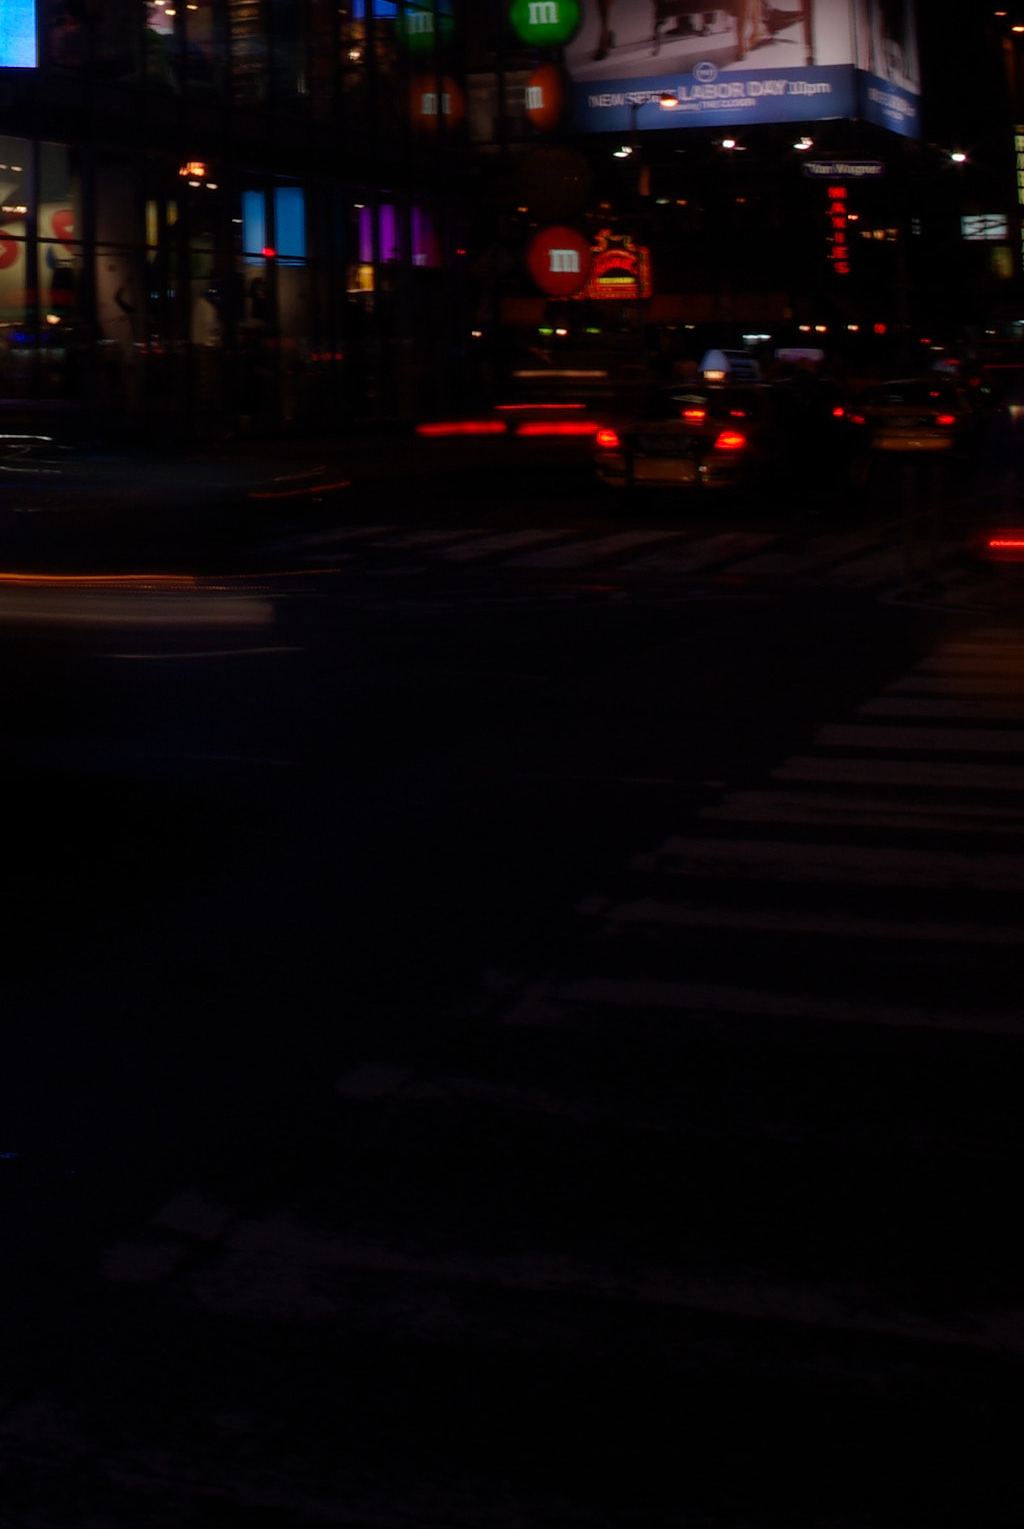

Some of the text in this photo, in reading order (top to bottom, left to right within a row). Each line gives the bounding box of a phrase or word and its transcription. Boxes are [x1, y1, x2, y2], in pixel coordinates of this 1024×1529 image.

[528, 1, 559, 25] m
[678, 83, 745, 101] LABOR
[747, 79, 788, 97] DAY
[548, 249, 580, 273] m
